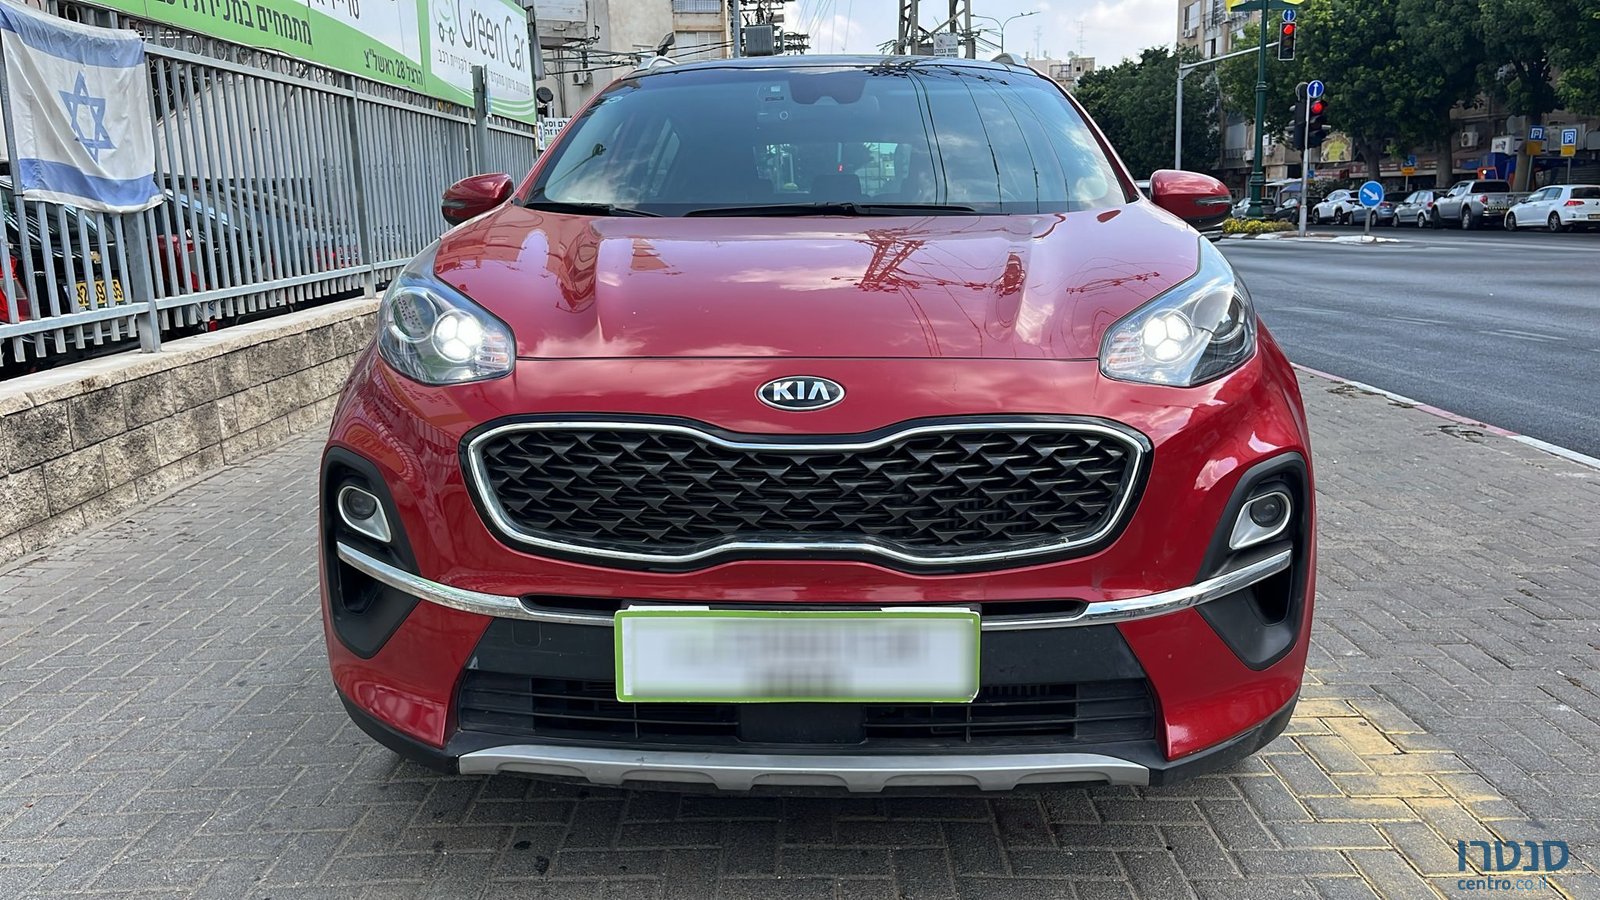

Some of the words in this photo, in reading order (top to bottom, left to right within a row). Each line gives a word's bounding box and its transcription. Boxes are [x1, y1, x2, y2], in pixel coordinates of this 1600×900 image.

[255, 4, 313, 46] מתמחים
[457, 0, 504, 63] Green
[504, 15, 525, 73] Car
[395, 58, 406, 80] 28
[405, 61, 424, 87] הרצל
[773, 381, 831, 401] KIA
